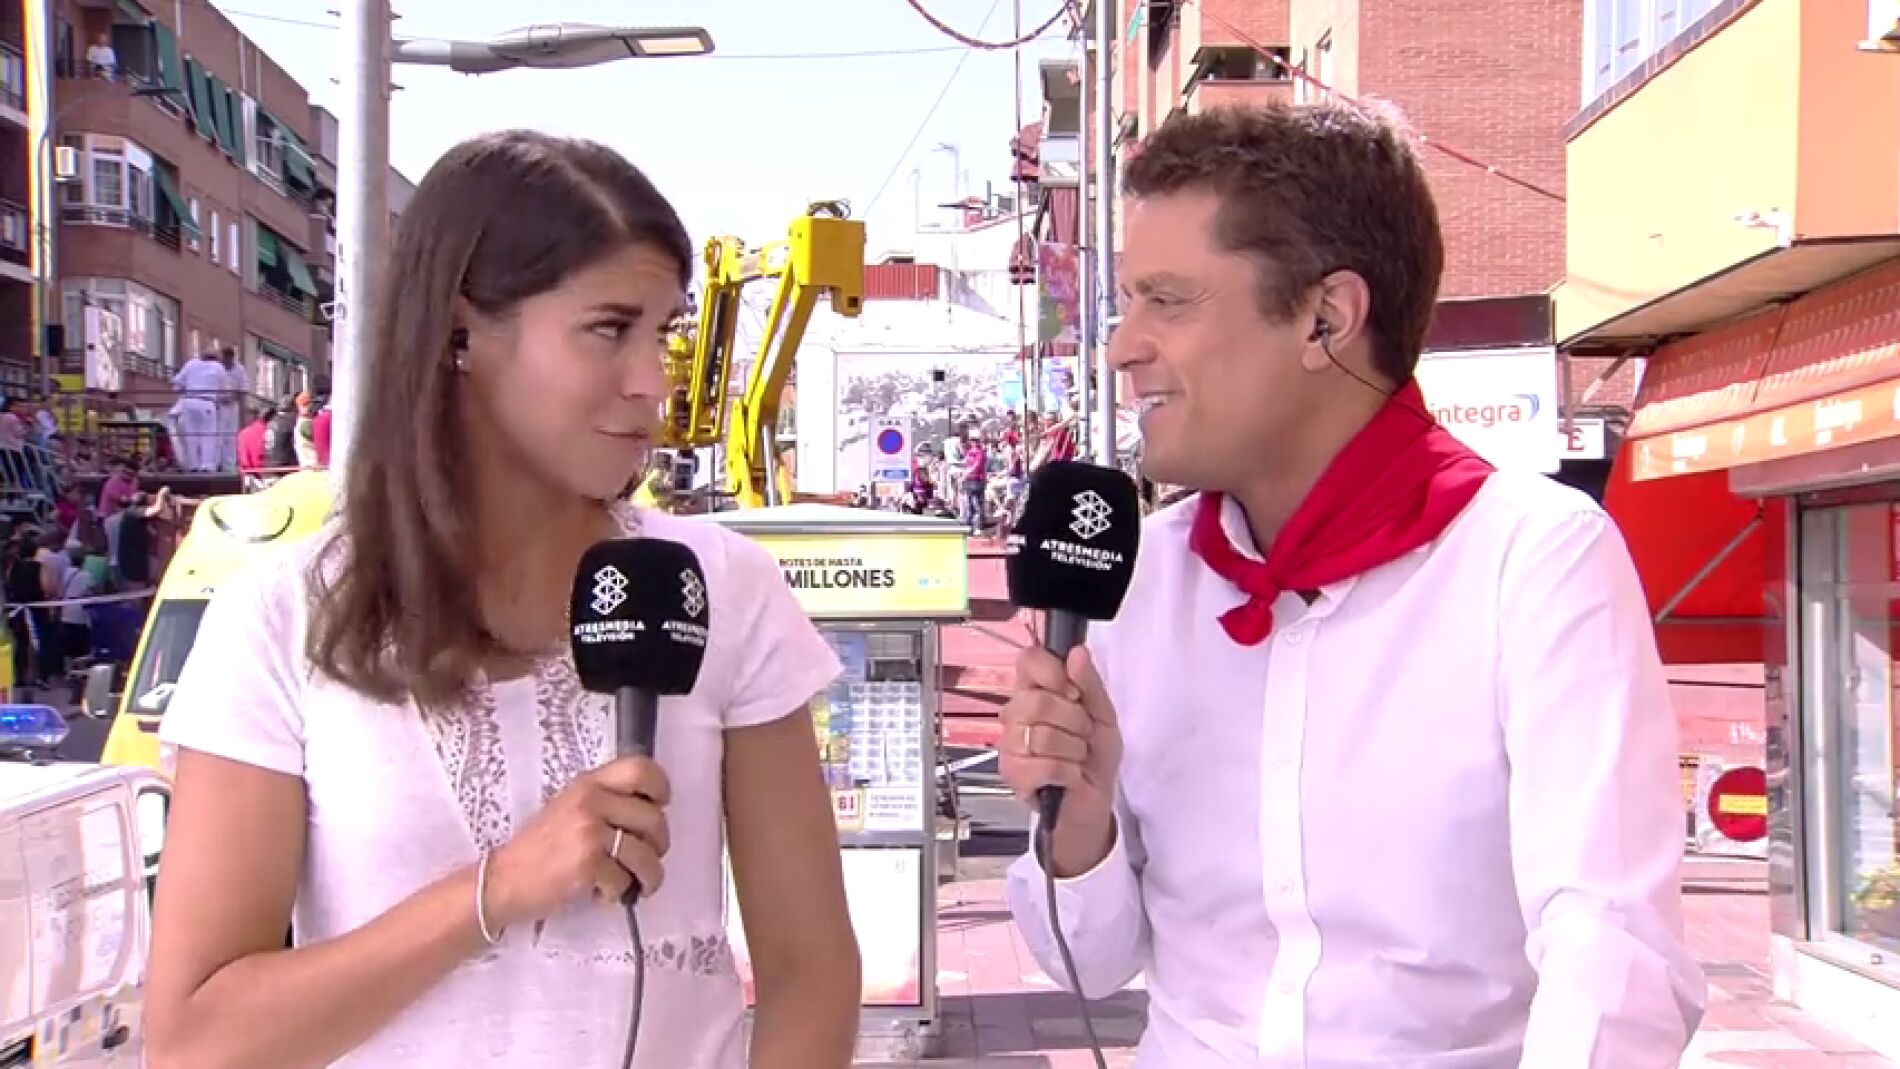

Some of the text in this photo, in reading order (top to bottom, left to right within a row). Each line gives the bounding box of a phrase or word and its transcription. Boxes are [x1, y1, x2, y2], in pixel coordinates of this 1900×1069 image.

[1428, 402, 1521, 427] integra
[1040, 539, 1124, 563] ATRESMEDIA
[783, 569, 896, 588] MILLONES
[574, 620, 646, 635] ATRESMEDIA
